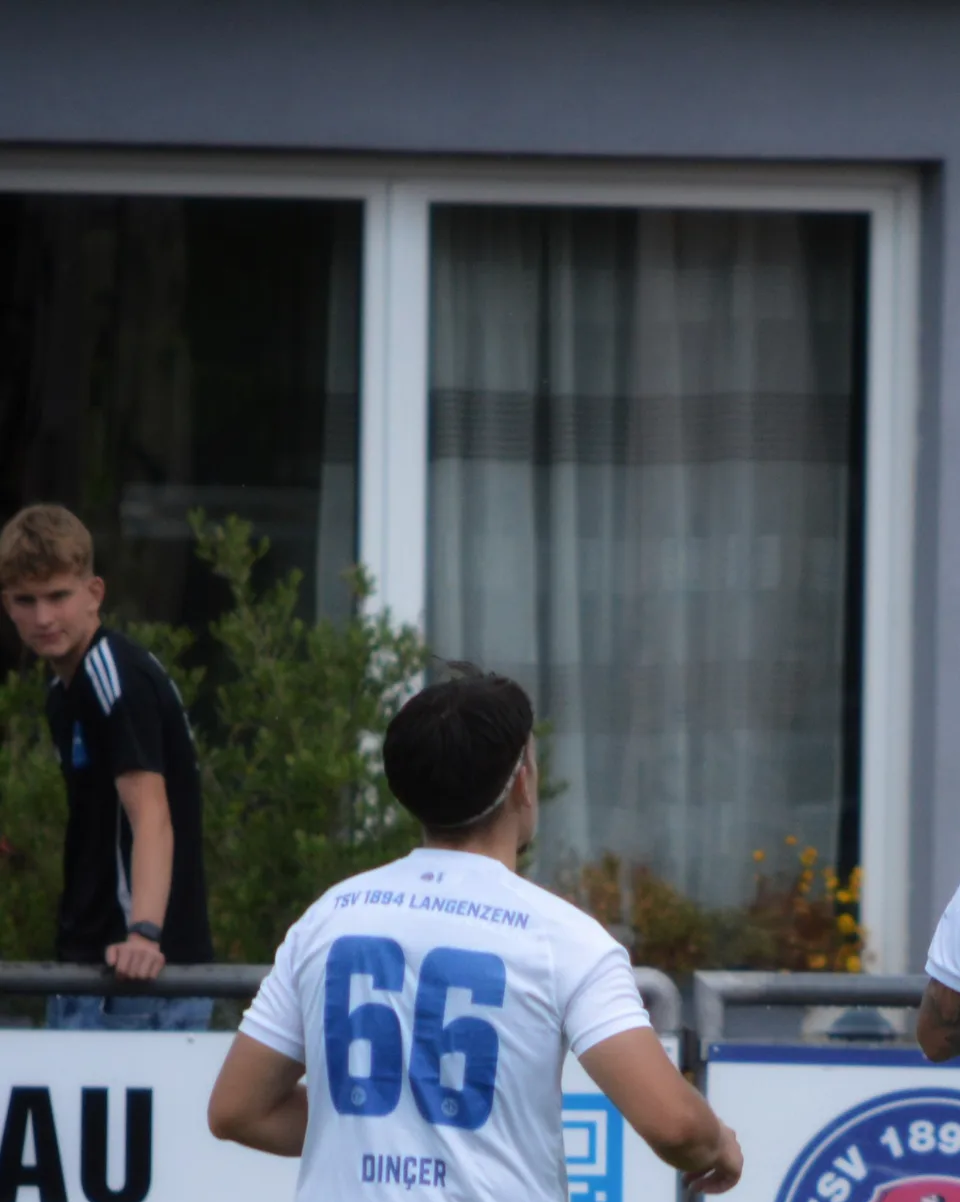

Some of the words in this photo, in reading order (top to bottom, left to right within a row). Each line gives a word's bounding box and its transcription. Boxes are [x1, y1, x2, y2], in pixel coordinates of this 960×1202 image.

[334, 890, 361, 910] TSV
[363, 889, 406, 905] 1894
[408, 893, 531, 930] LANGENZENN
[322, 934, 507, 1131] 66
[361, 1153, 447, 1191] DINÇER
